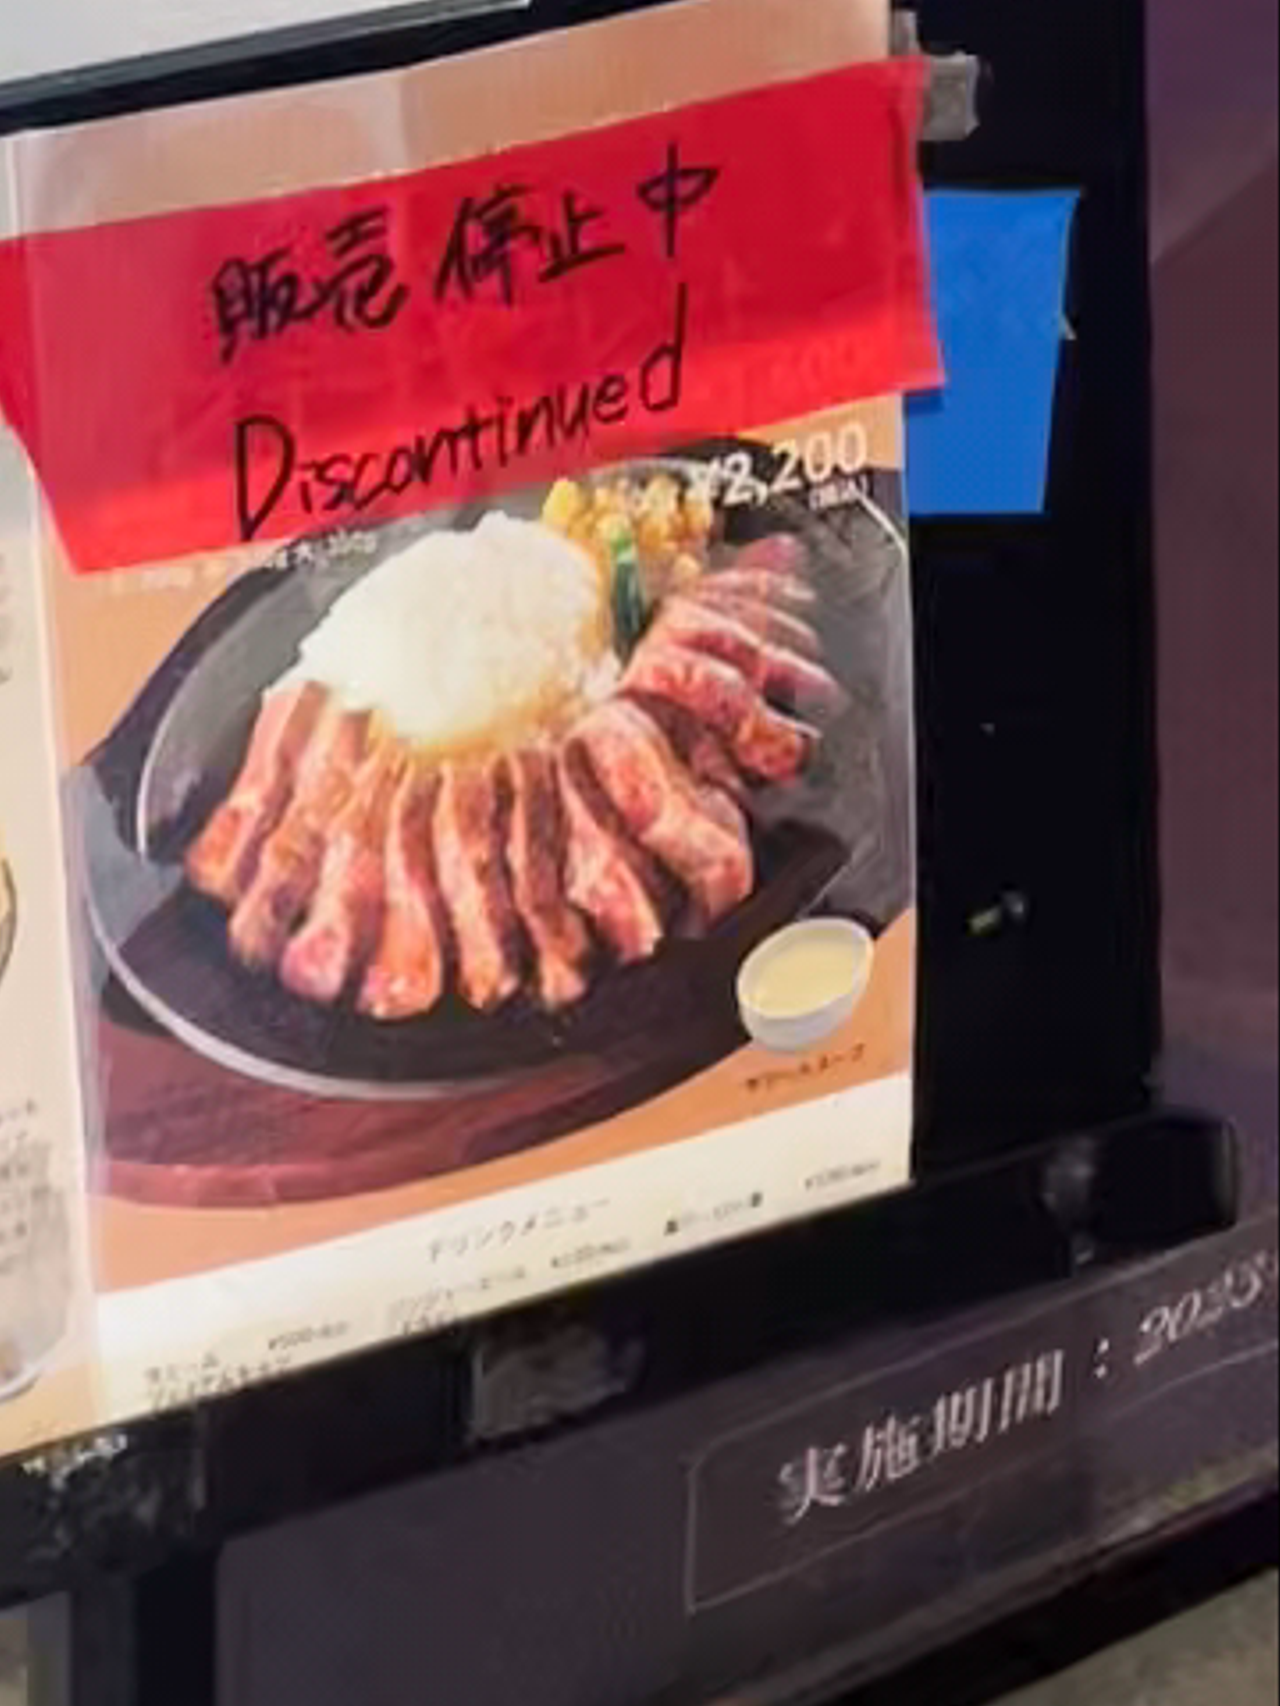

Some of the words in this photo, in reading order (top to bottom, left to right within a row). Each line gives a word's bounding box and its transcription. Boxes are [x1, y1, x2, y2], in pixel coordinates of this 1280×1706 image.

[213, 142, 719, 367] 販売停止中
[236, 281, 686, 542] Discontinued
